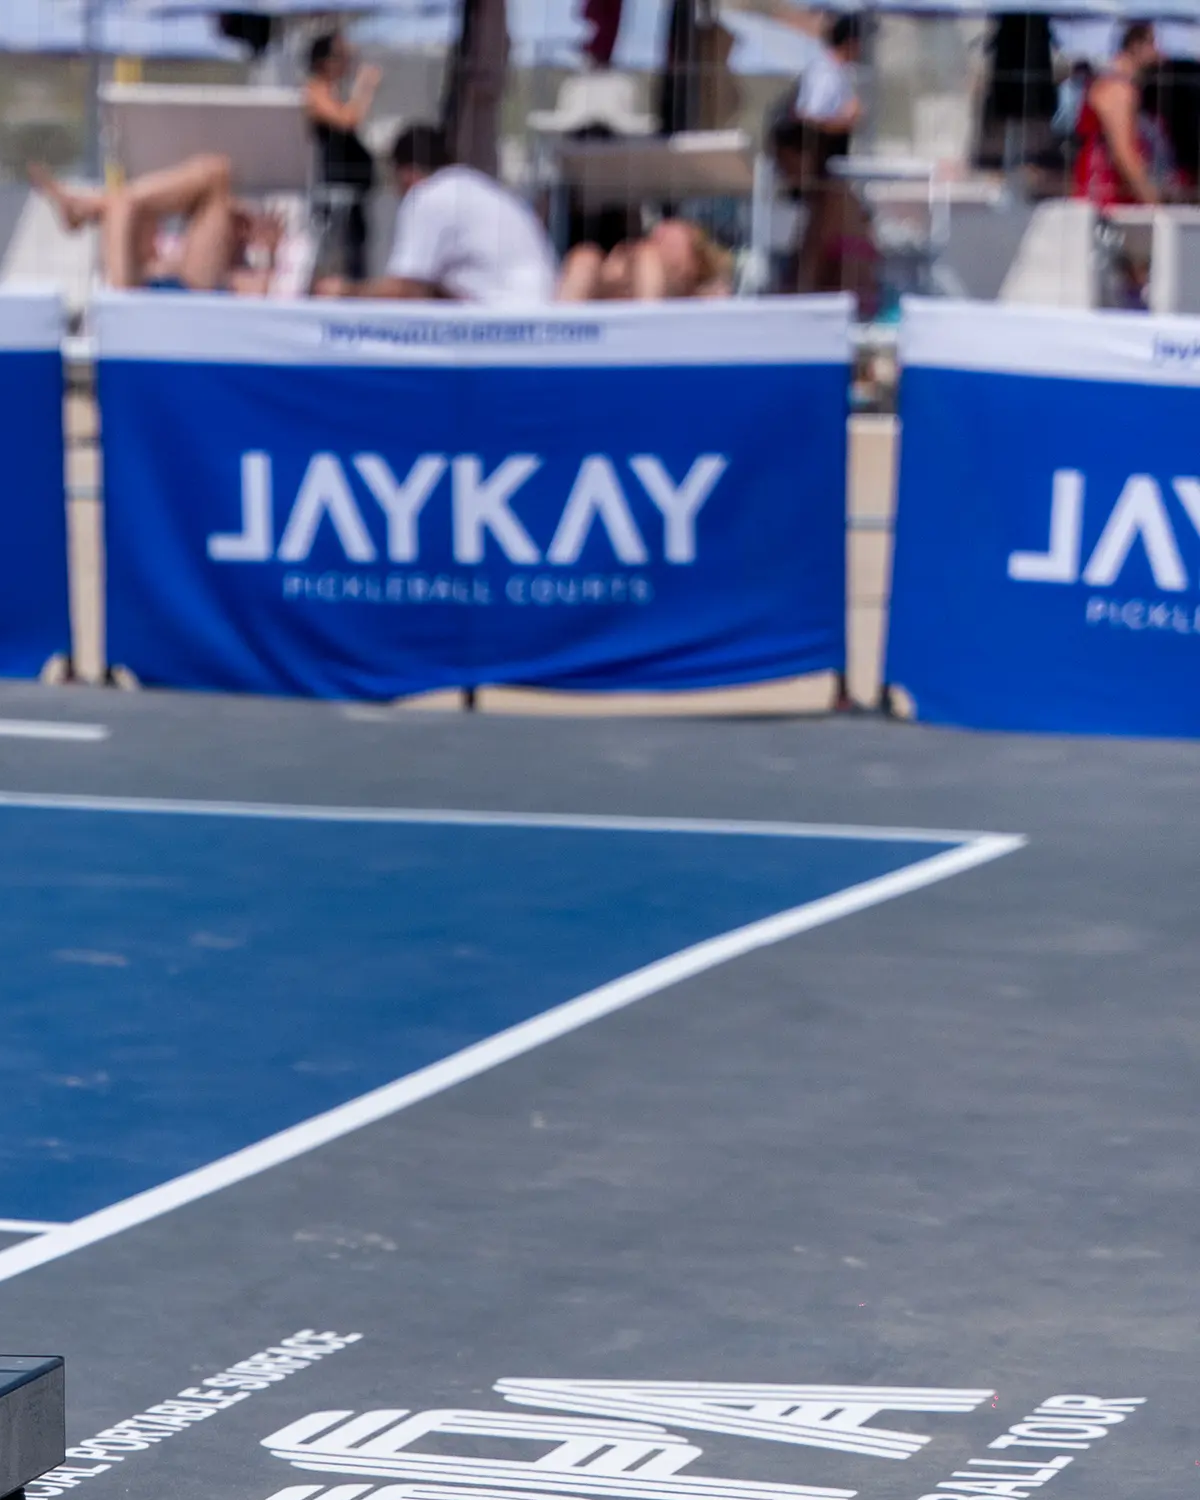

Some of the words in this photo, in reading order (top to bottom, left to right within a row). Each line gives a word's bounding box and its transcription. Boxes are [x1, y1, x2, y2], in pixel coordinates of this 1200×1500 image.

[207, 451, 727, 565] JAYKAY
[65, 1387, 252, 1462] PORTABLE
[202, 1329, 364, 1390] SURFACE
[988, 1394, 1147, 1450] TOUR
